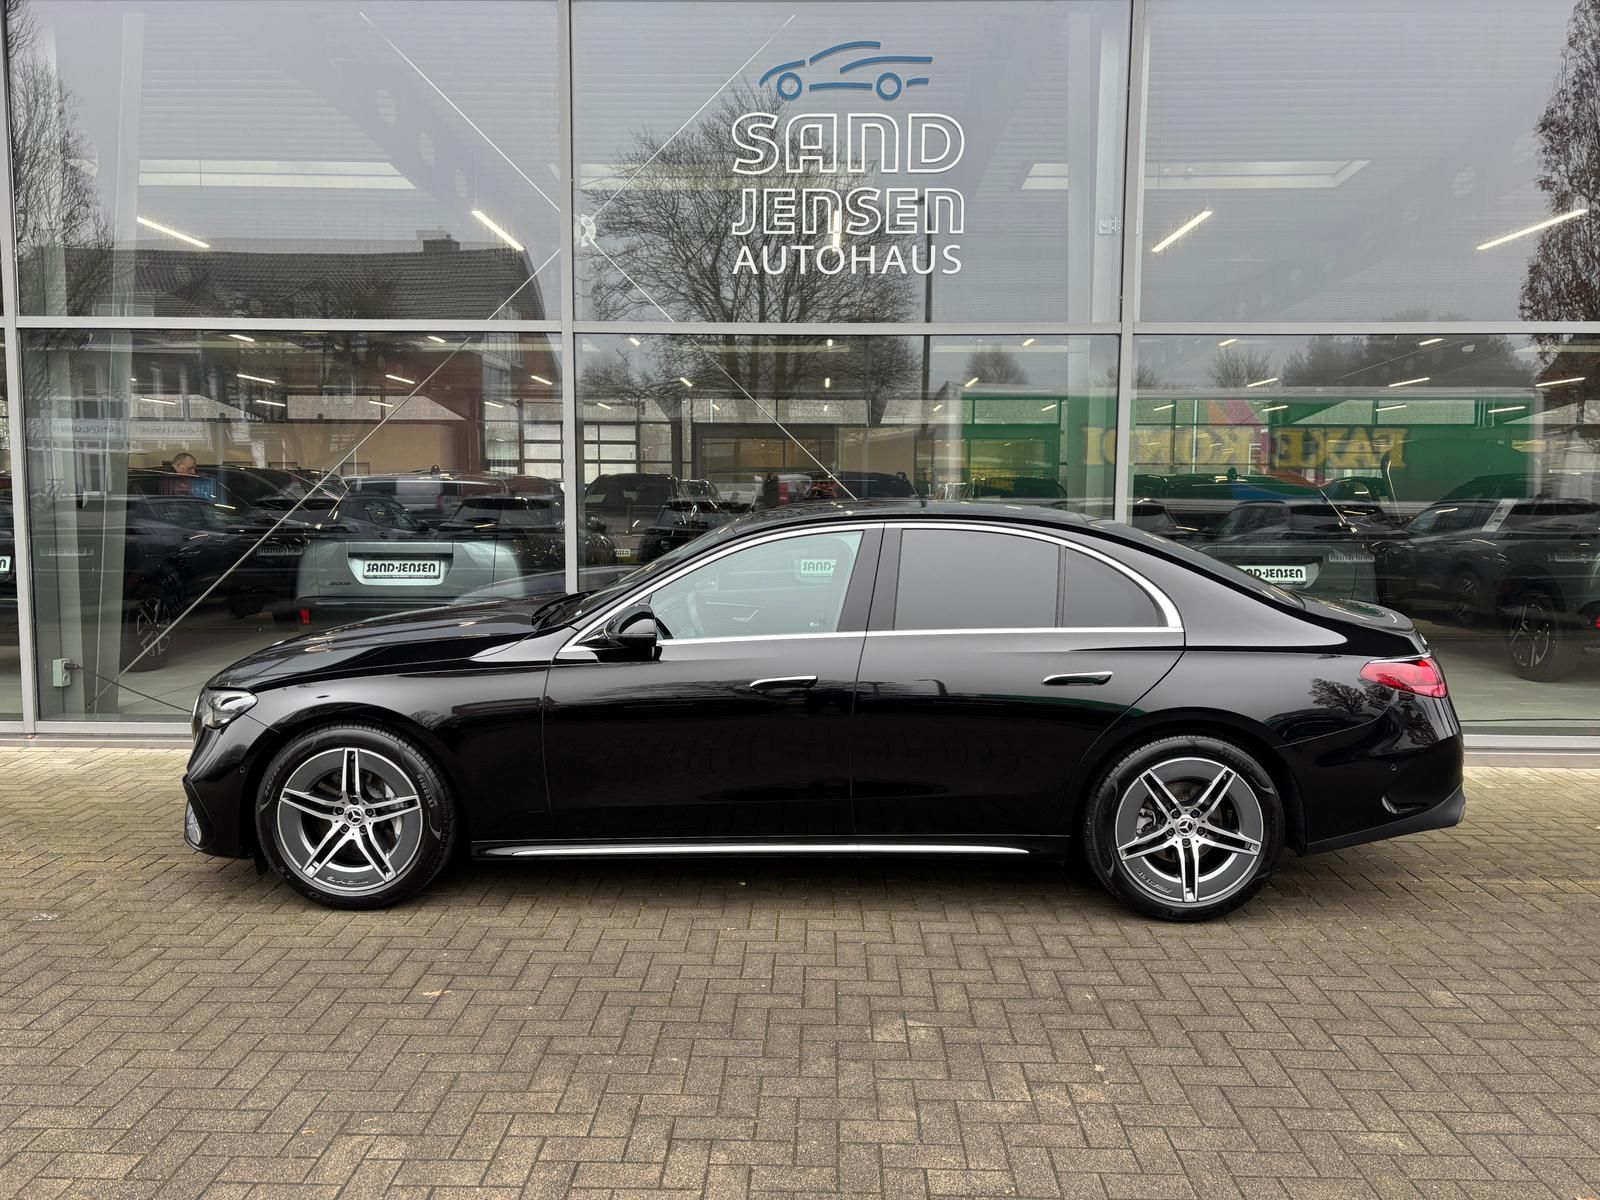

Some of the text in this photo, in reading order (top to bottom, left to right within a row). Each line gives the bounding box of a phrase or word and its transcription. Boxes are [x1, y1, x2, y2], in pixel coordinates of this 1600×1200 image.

[731, 112, 965, 175] SAND
[731, 187, 965, 235] JENSEN
[732, 244, 962, 275] AUTOHAUS
[416, 774, 435, 808] PIRELLI
